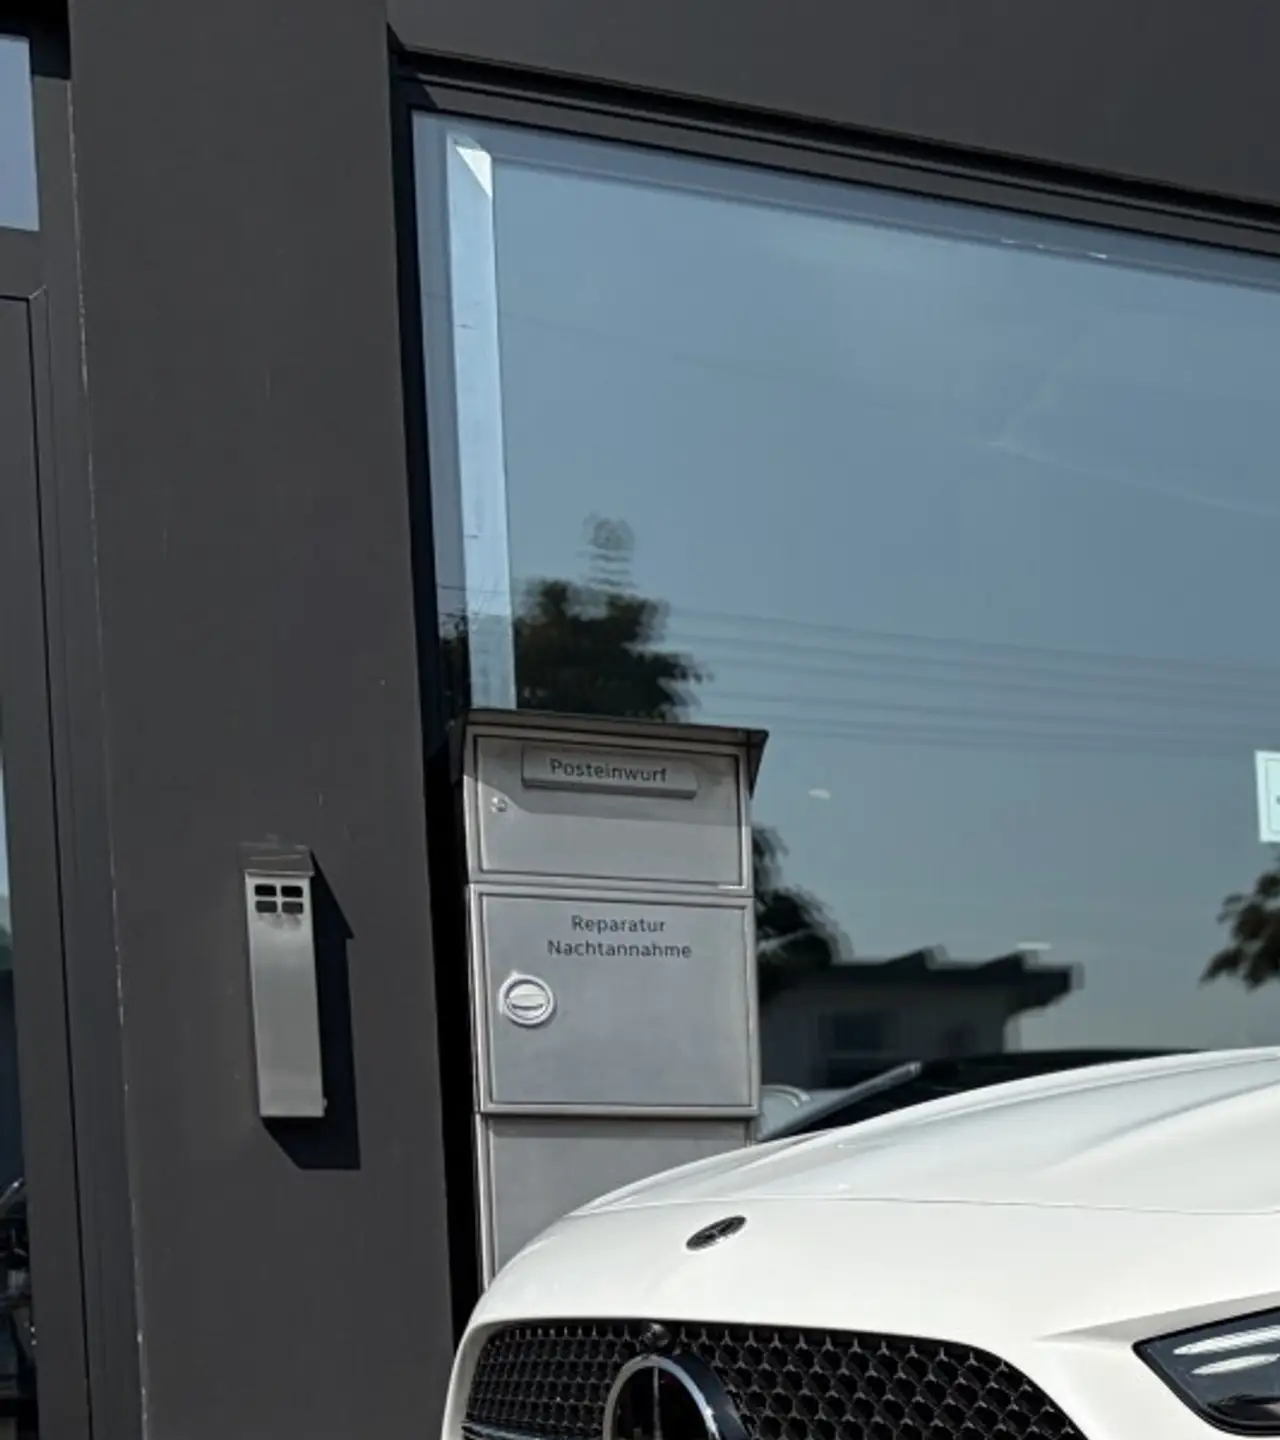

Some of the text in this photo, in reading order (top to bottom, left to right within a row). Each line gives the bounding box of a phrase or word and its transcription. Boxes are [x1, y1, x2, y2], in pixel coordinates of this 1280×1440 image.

[549, 758, 668, 784] Posteinwurf
[570, 914, 666, 934] Reparatur
[547, 940, 692, 960] Nachtannahme
